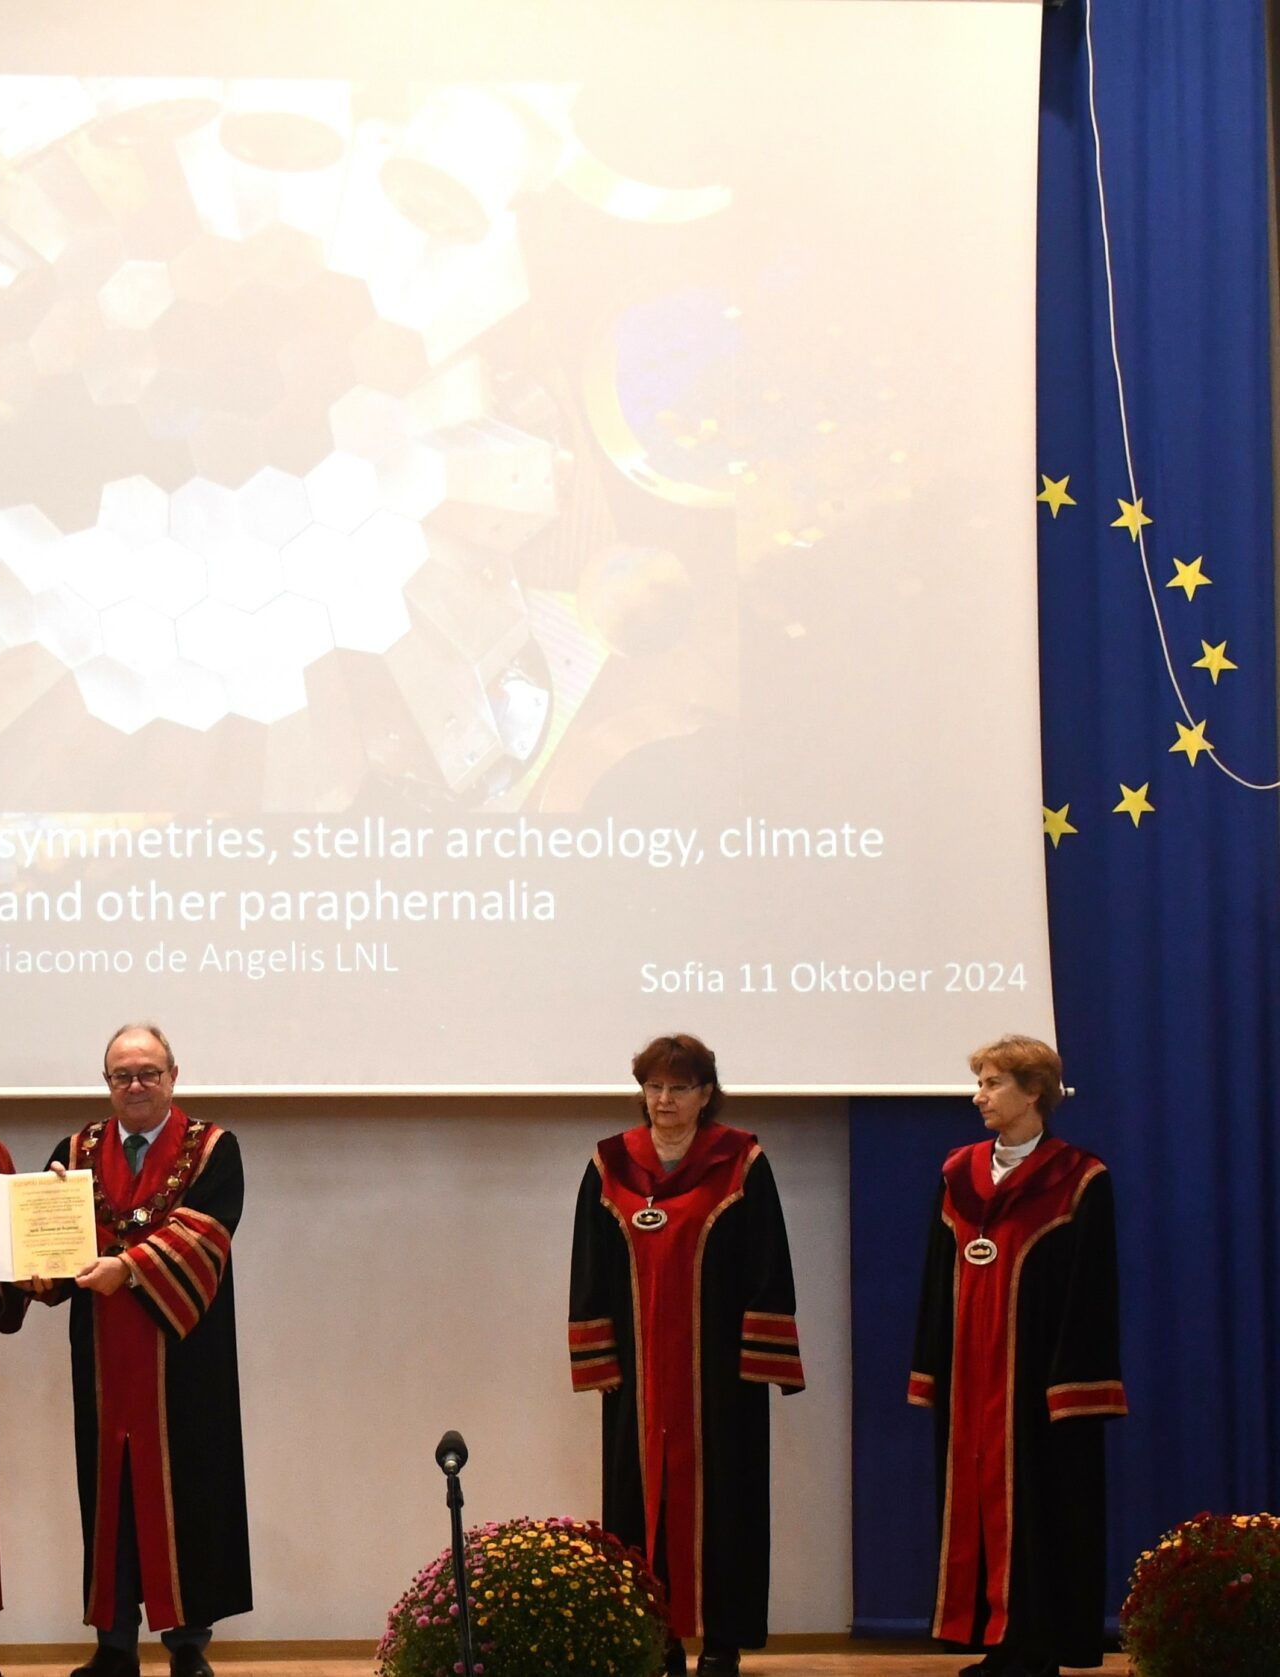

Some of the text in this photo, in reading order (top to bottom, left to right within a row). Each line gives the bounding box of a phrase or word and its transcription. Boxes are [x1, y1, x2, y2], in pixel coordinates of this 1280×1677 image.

[292, 815, 434, 859] stellar
[446, 816, 705, 868] archeology,
[720, 816, 884, 858] climate
[96, 879, 227, 922] other
[239, 878, 556, 931] paraphernalia
[144, 940, 188, 974] de
[198, 940, 326, 980] Angelis
[335, 942, 400, 973] LNL
[640, 960, 1029, 993] Sofia 11 Oktober 2024
